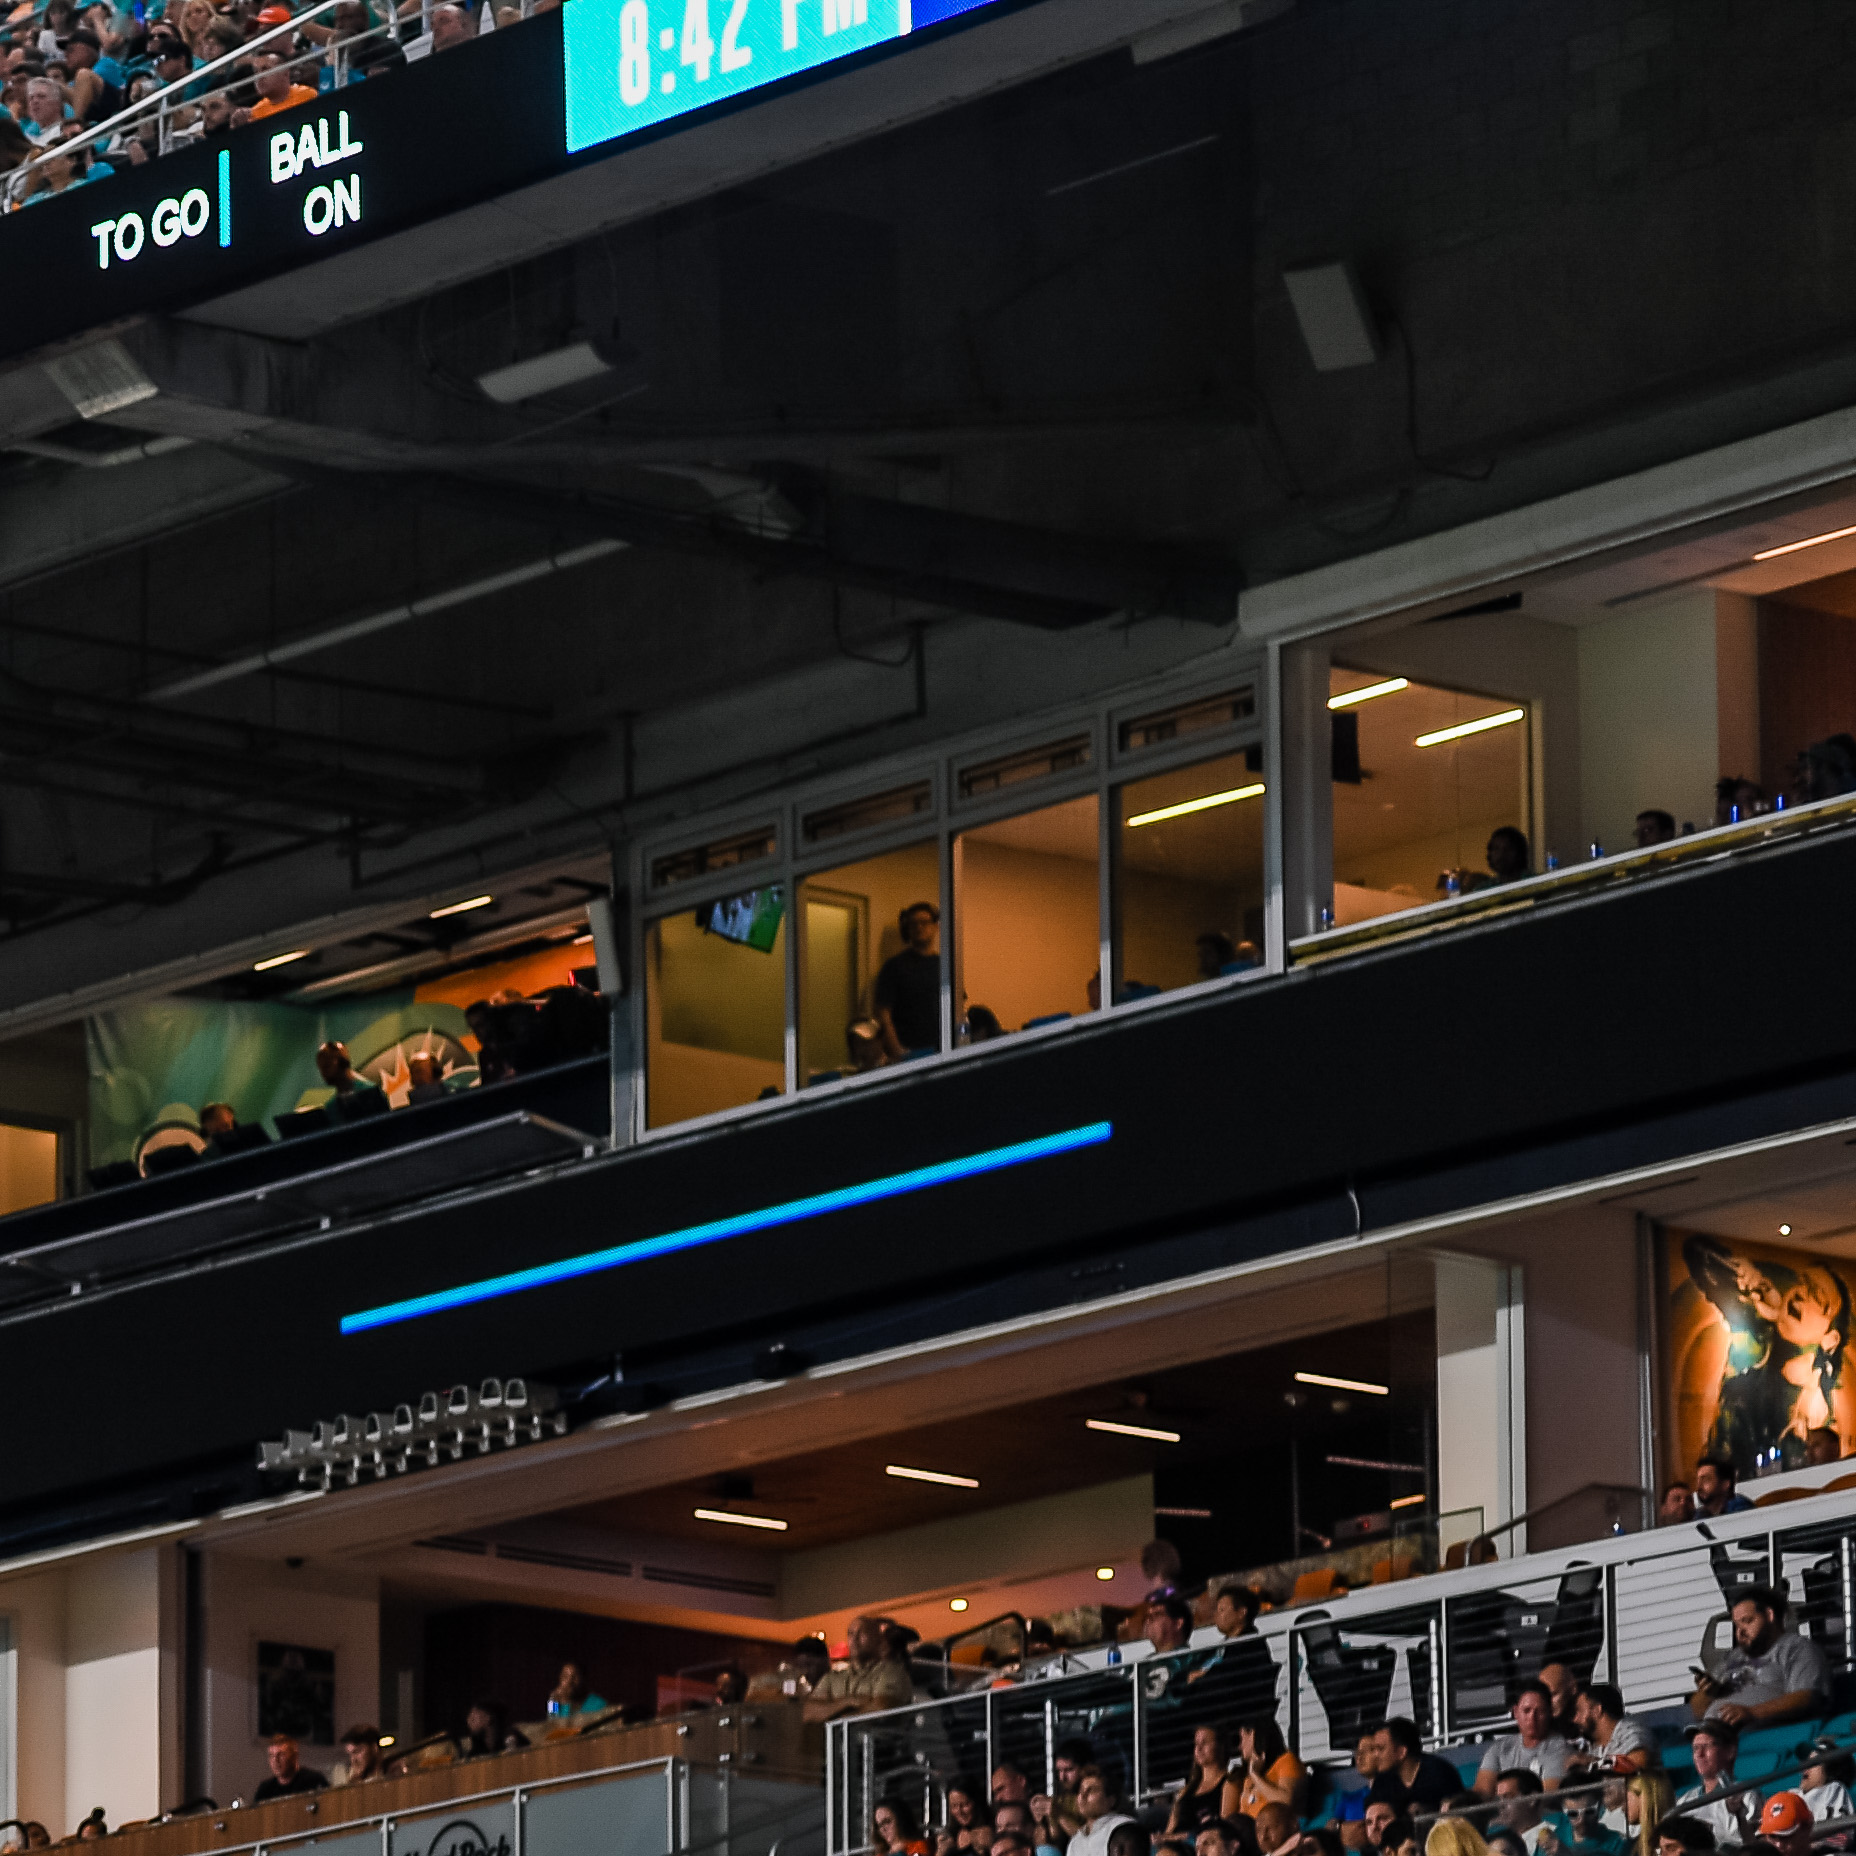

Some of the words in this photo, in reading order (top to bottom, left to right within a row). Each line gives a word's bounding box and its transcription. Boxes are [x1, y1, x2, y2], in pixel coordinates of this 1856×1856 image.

[619, 0, 752, 106] 8:42
[270, 110, 363, 184] BALL
[91, 212, 144, 269] TO
[150, 187, 210, 247] GO
[302, 173, 361, 236] ON
